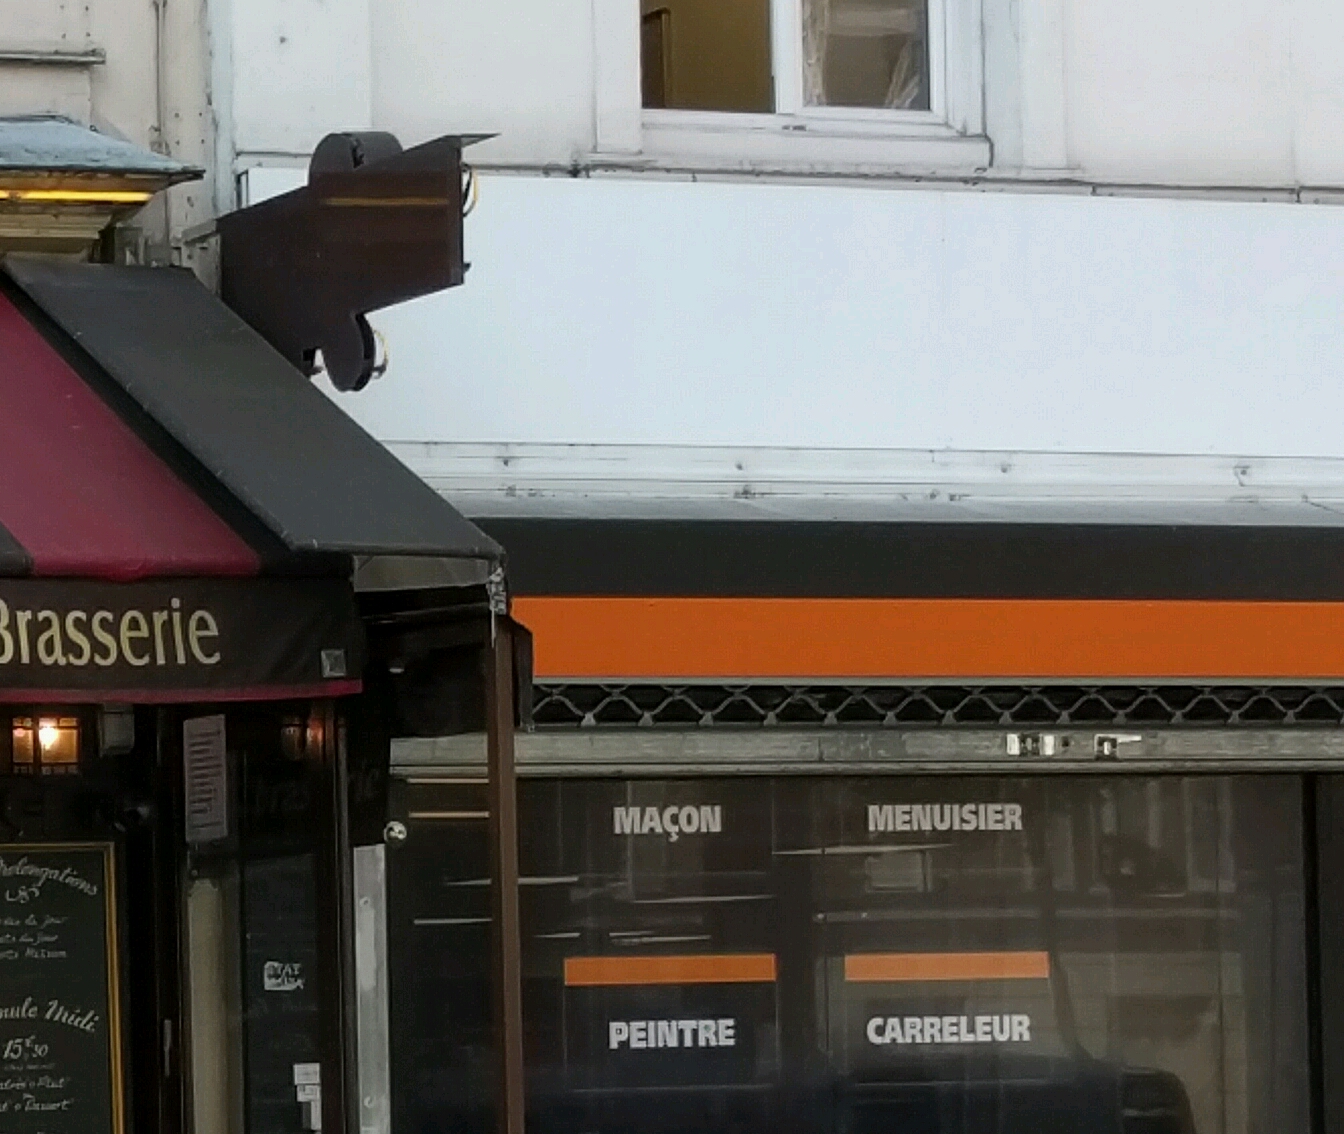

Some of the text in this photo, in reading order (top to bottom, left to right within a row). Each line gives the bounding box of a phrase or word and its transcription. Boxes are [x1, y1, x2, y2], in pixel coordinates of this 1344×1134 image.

[613, 805, 722, 843] MAÇON
[867, 803, 1023, 832] MENUISIER
[45, 1000, 100, 1033] Midi
[866, 1014, 1031, 1045] CARRELEUR
[608, 1018, 736, 1050] PEINTRE
